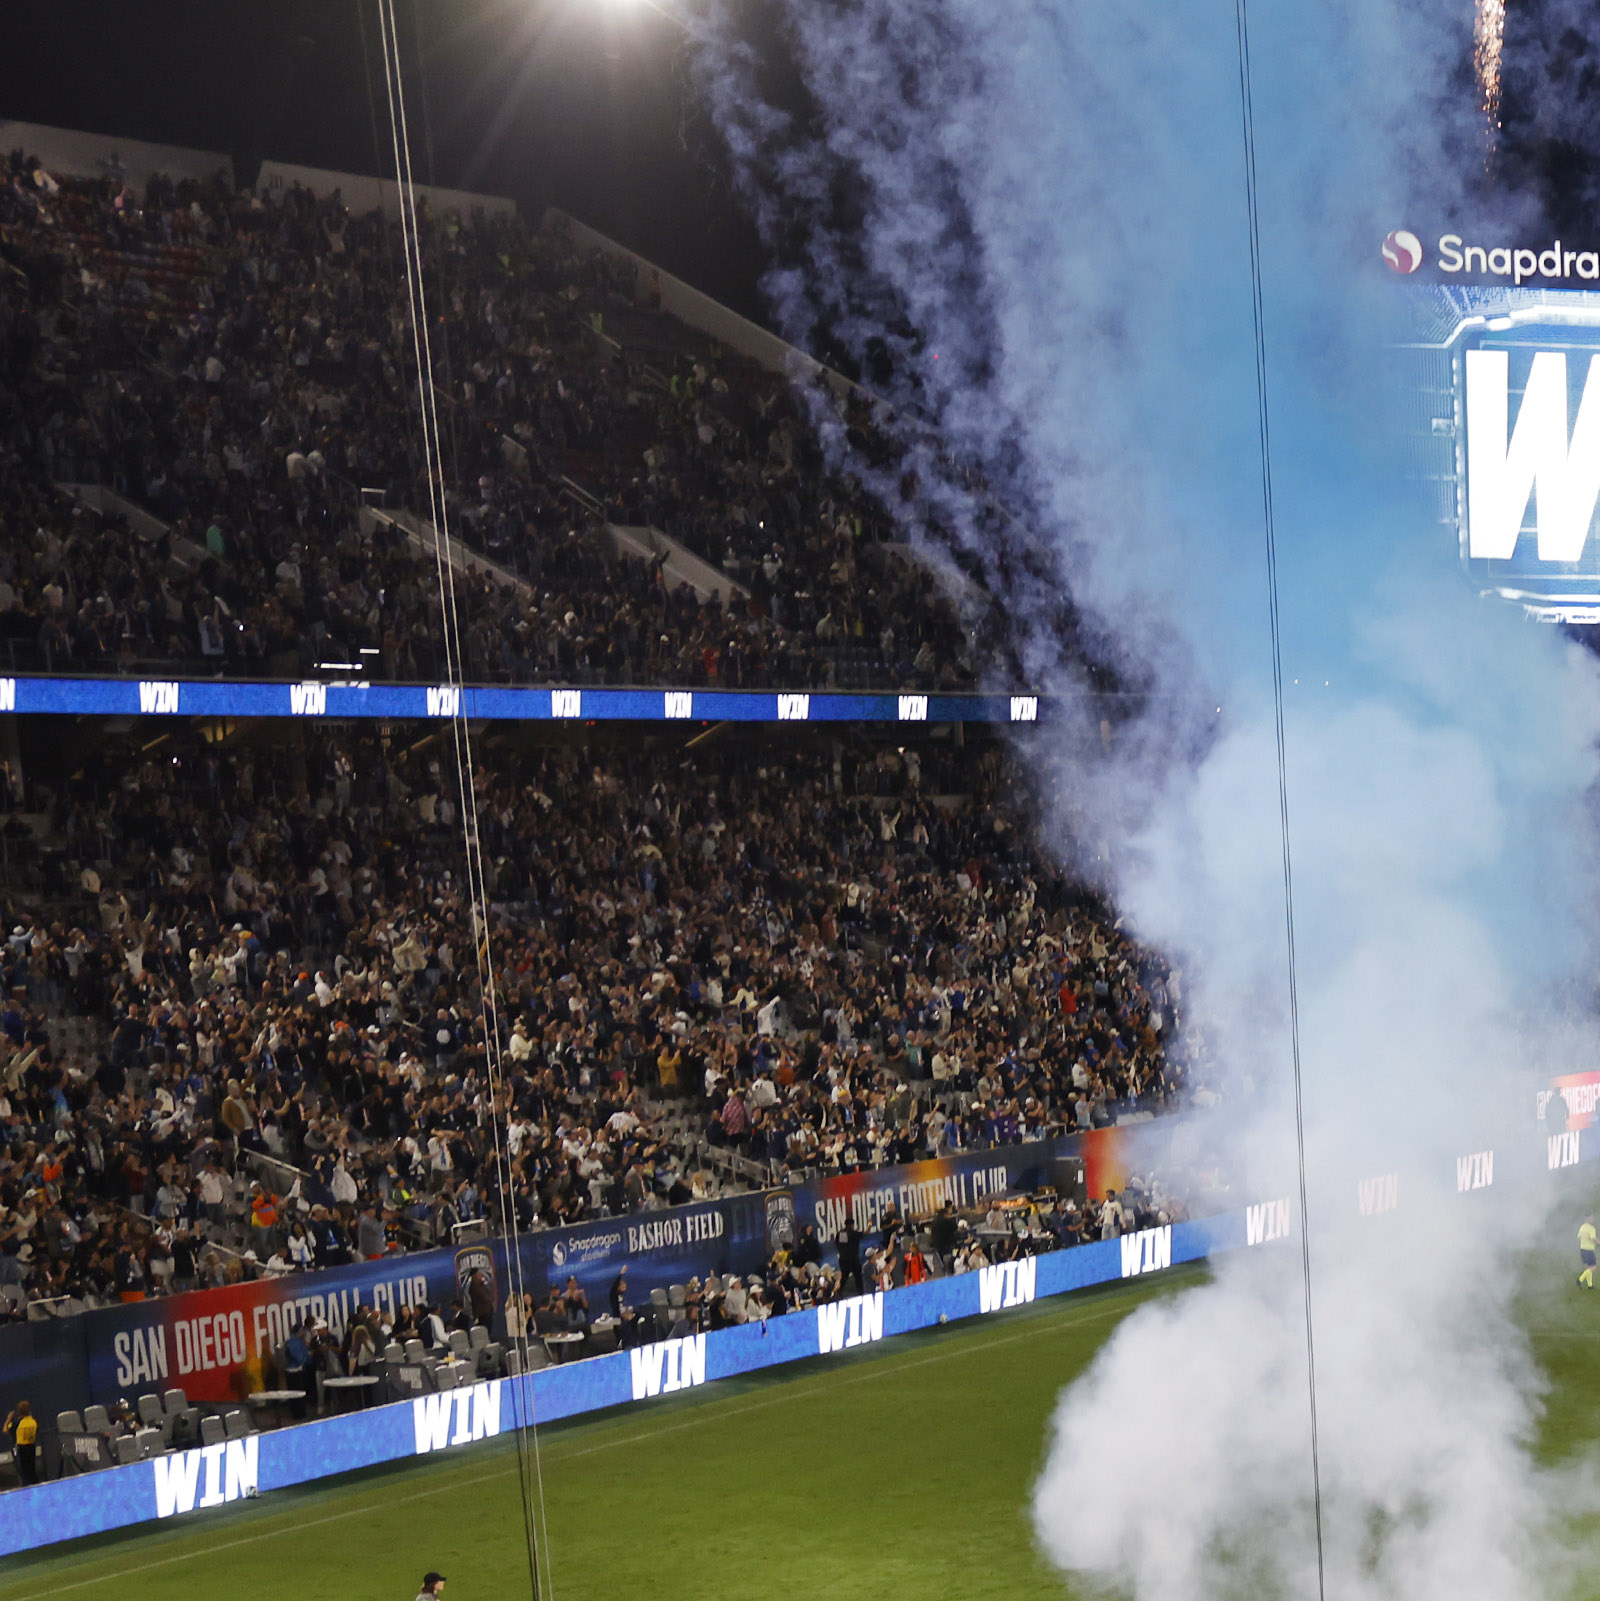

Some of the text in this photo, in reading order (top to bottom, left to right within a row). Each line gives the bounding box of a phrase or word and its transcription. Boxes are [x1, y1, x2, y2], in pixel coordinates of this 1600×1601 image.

[140, 681, 179, 713] WIN
[290, 684, 327, 714] WIN
[427, 687, 459, 716] WIN
[551, 690, 581, 717] WIN
[665, 692, 692, 718] WIN
[777, 694, 809, 720] WIN
[898, 695, 928, 720] WIN
[1010, 696, 1038, 721] WIN
[1547, 1130, 1580, 1170] WIN
[1457, 1150, 1494, 1193] WIN
[568, 1231, 621, 1252] Snapdragon
[627, 1211, 725, 1254] BASHOR FIELD
[1246, 1197, 1291, 1247] WIN
[1121, 1224, 1172, 1278] WIN
[979, 1256, 1037, 1314] WIN
[816, 1292, 884, 1354] WIN
[114, 1324, 167, 1388] SAN
[174, 1309, 247, 1376] DIEGO
[630, 1333, 707, 1401] WIN
[413, 1379, 502, 1455] WIN
[154, 1436, 260, 1519] WIN
